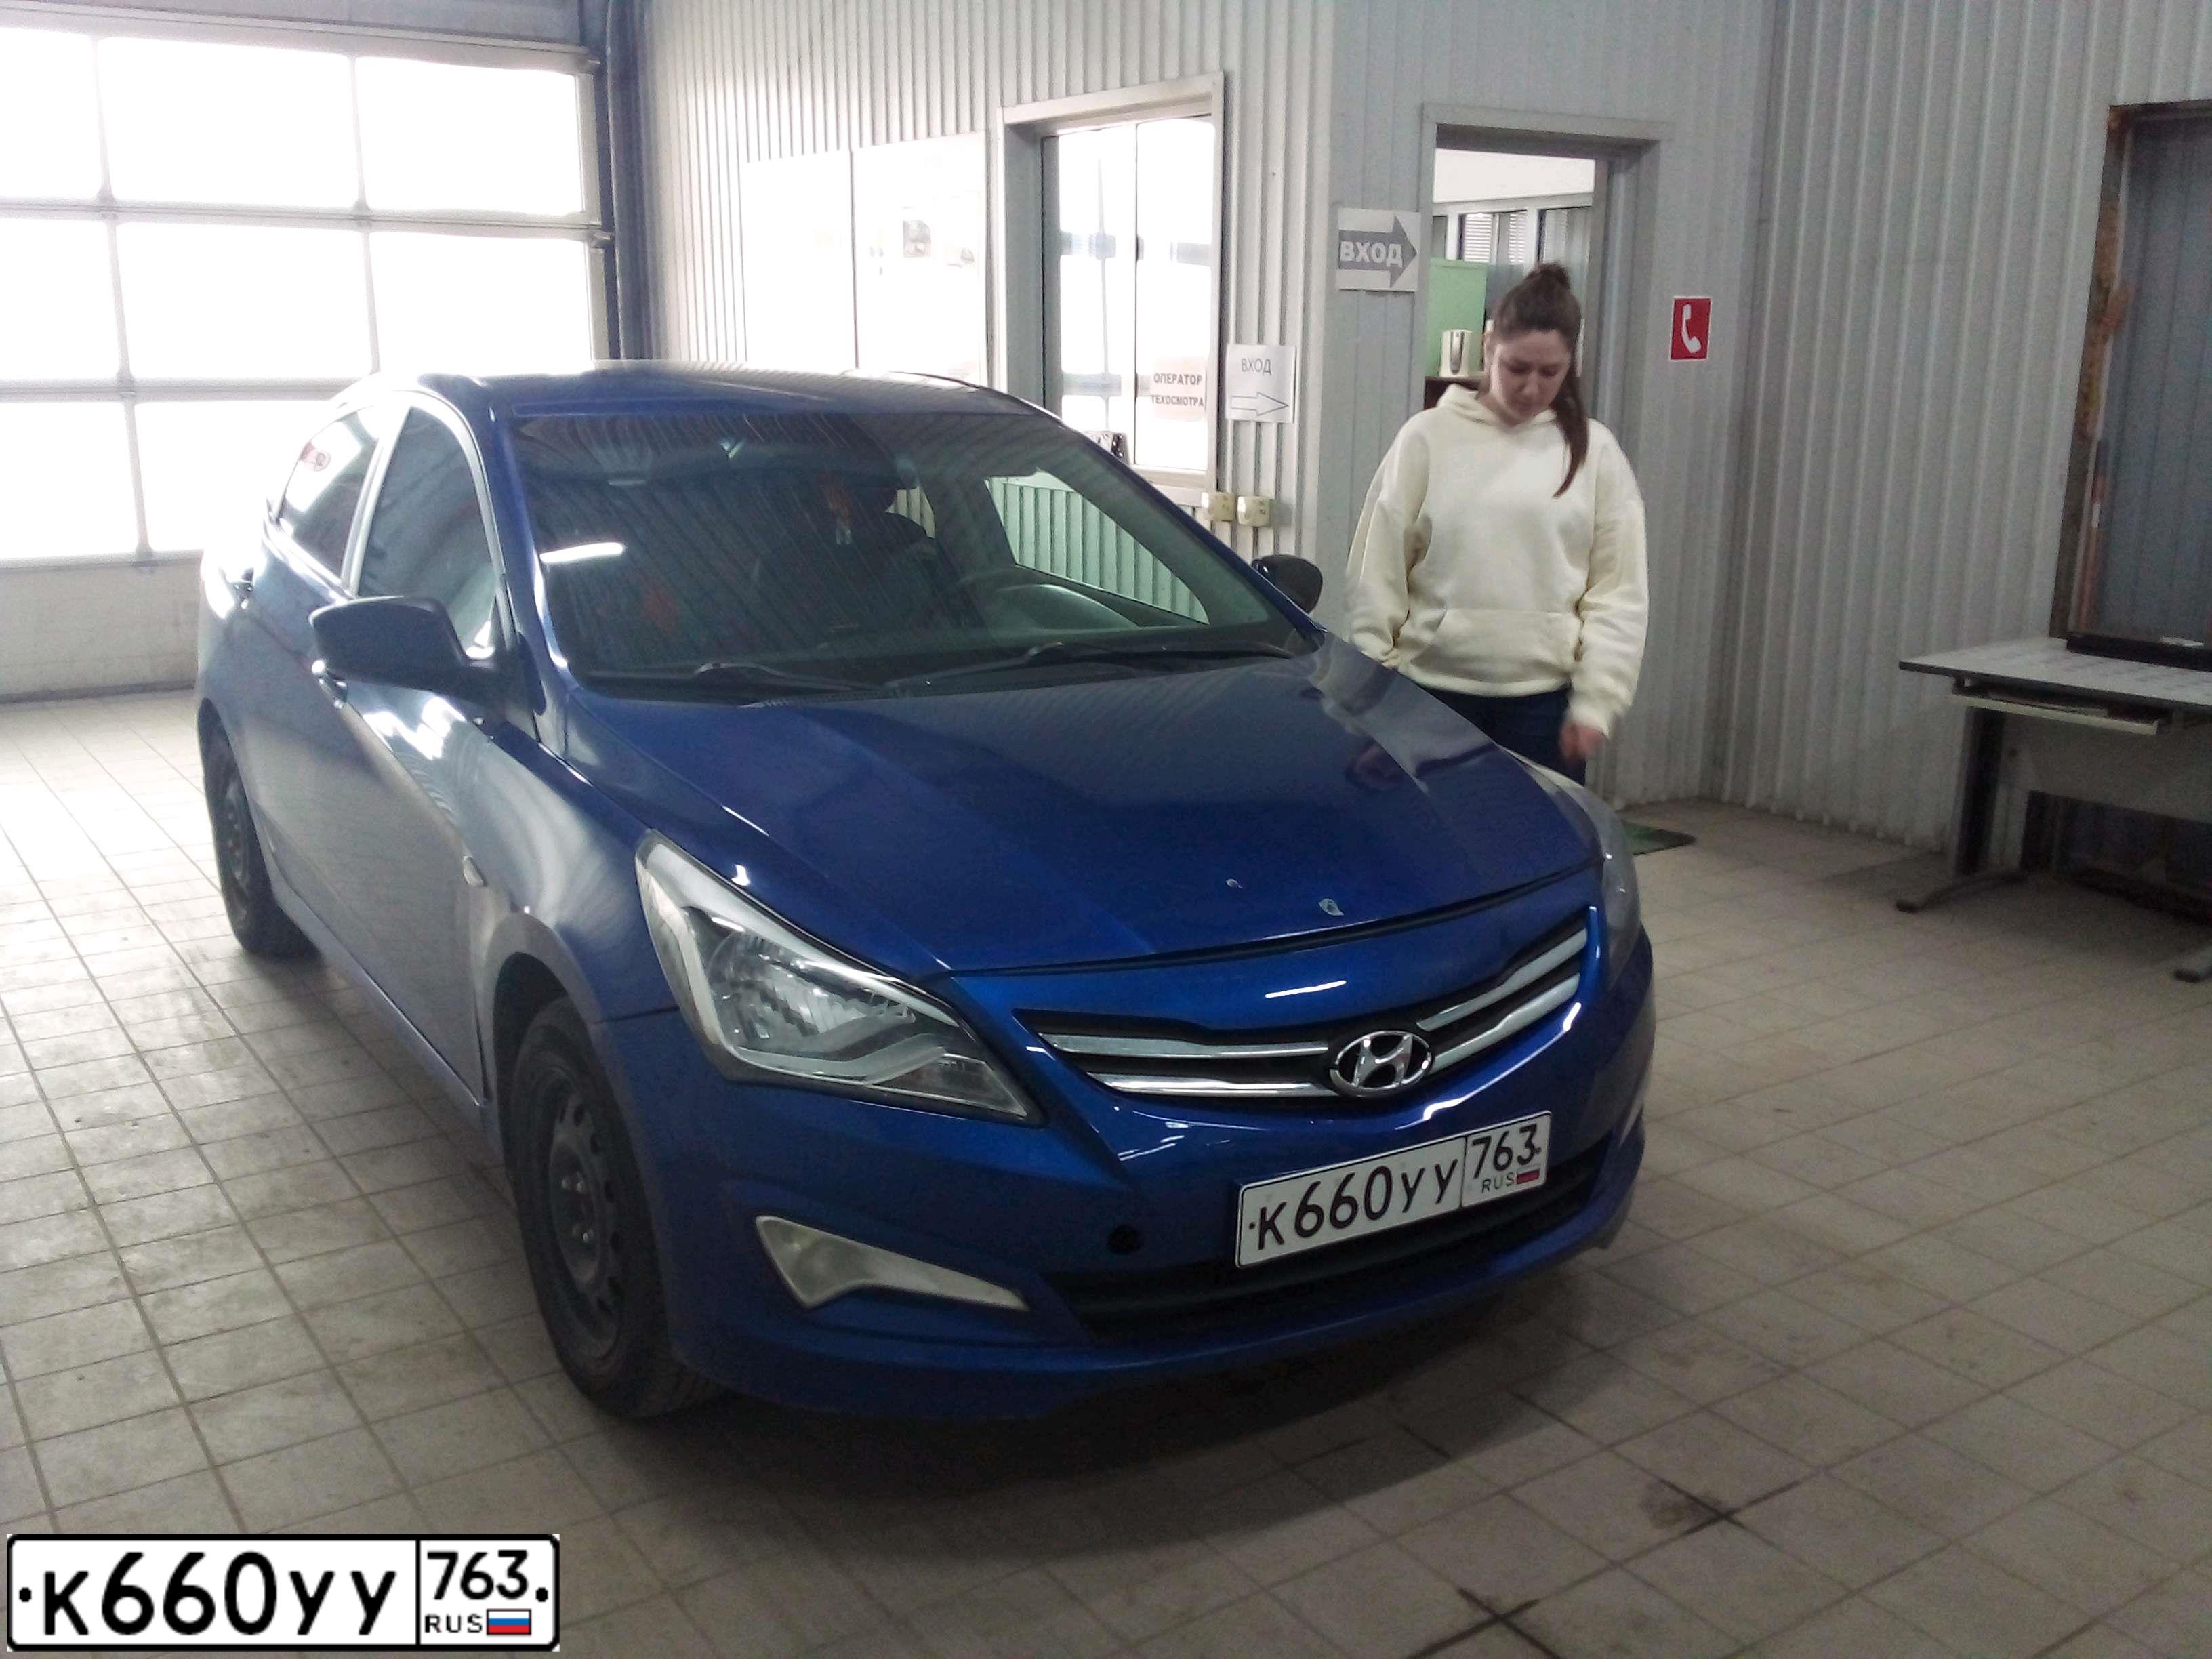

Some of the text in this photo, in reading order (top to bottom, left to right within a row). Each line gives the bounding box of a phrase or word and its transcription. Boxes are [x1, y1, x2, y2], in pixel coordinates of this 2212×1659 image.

[1339, 240, 1404, 268] ВХОД
[1241, 356, 1273, 376] ВХОД
[1153, 372, 1202, 386] ОПЕРАТОР
[1151, 394, 1204, 407] ТЕХОСМОТРА
[1257, 1124, 1538, 1251] К660УУ 763
[1481, 1172, 1517, 1193] RUS
